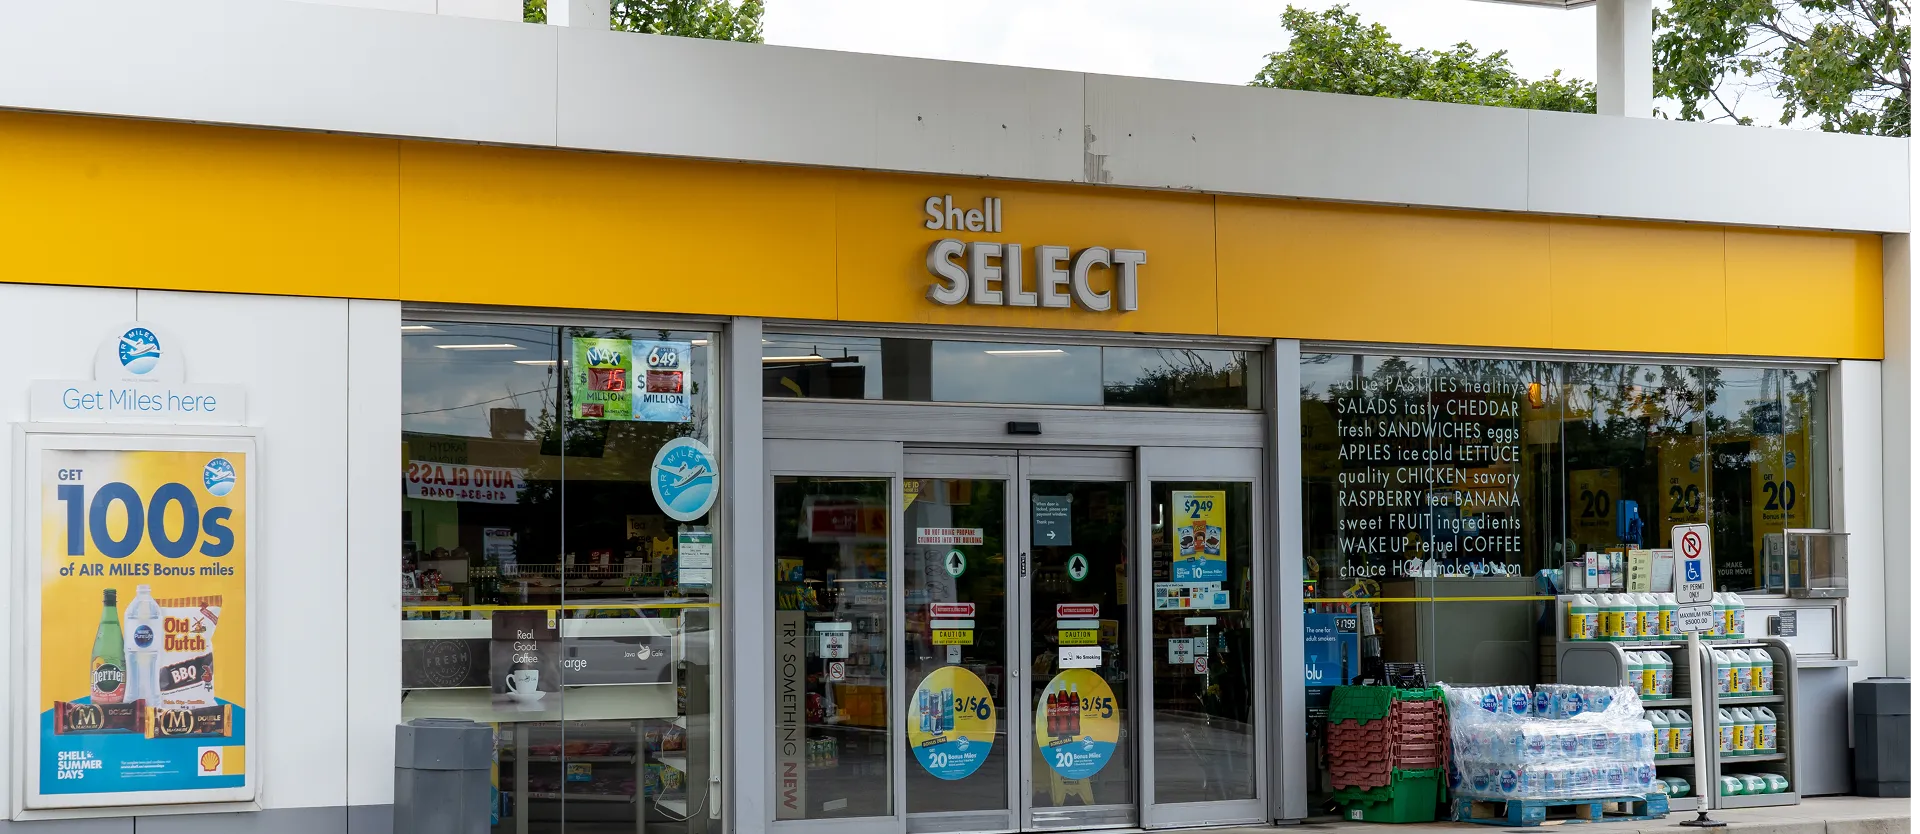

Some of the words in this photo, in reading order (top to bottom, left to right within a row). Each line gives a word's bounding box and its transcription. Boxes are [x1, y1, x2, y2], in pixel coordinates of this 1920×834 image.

[925, 195, 1002, 232] Shell
[926, 238, 1147, 312] SELECT
[128, 330, 155, 342] MILES
[586, 349, 621, 366] MAX
[1336, 374, 1378, 391] value
[1386, 376, 1457, 393] PASTRIES
[1465, 377, 1519, 399] healthy
[62, 388, 103, 411] Get
[109, 388, 163, 411] Miles
[167, 389, 217, 412] here
[587, 392, 624, 401] MILLION
[644, 394, 683, 404] MILLION
[1337, 398, 1397, 414] SALADS
[1404, 402, 1439, 420] tasty
[1446, 400, 1519, 417] CHEDDAR
[1337, 419, 1372, 438] fresh
[1378, 421, 1481, 439] SANDWICHES
[1486, 428, 1519, 444] eggs
[1338, 444, 1391, 461] APPLES
[1398, 446, 1418, 461] ice
[1422, 444, 1452, 461] cold
[1459, 446, 1519, 462] LETTUCE
[58, 469, 83, 481] GET
[661, 474, 671, 496] AIR
[667, 450, 701, 464] MILES
[1338, 468, 1390, 489] quality
[1396, 468, 1467, 484] CHICKEN
[1473, 472, 1520, 489] savory
[1763, 473, 1774, 481] GET
[1339, 491, 1422, 507] RASPBERRY
[1426, 492, 1448, 507] tea
[1454, 491, 1520, 507] BANANA
[1580, 489, 1610, 518] 20
[1669, 483, 1699, 513] 20
[1762, 480, 1795, 511] 20
[57, 481, 235, 558] 100s
[1339, 516, 1382, 530] sweet
[1389, 513, 1430, 530] FRUIT
[1437, 513, 1521, 533] ingredients
[1340, 537, 1386, 552] WAKE
[1390, 537, 1409, 552] UP
[1416, 535, 1458, 552] refuel
[1463, 537, 1521, 552] COFFEE
[59, 563, 75, 577] of
[79, 563, 104, 576] AIR
[109, 563, 150, 576] MILES
[153, 563, 196, 576] Bonus
[200, 563, 234, 576] miles
[1192, 567, 1202, 578] 10
[1340, 559, 1386, 578] choice
[1688, 591, 1699, 599] ONLY
[1689, 583, 1705, 591] PERMIT
[164, 617, 189, 633] Old
[164, 634, 205, 651] Dutch
[516, 628, 534, 640] Real
[783, 621, 796, 647] TRY
[513, 641, 537, 652] Good
[512, 652, 538, 664] Coffee
[171, 665, 197, 684] BBQ
[1306, 664, 1322, 681] blu
[783, 653, 797, 756] SOMETHING
[955, 696, 991, 720] 3/$6
[1082, 695, 1113, 719] 3/$5
[58, 751, 86, 760] SHELL
[929, 752, 947, 768] 20
[1056, 752, 1073, 768] 20
[58, 760, 102, 770] SUMMER
[58, 769, 84, 780] DAYS
[783, 762, 798, 810] NEW
